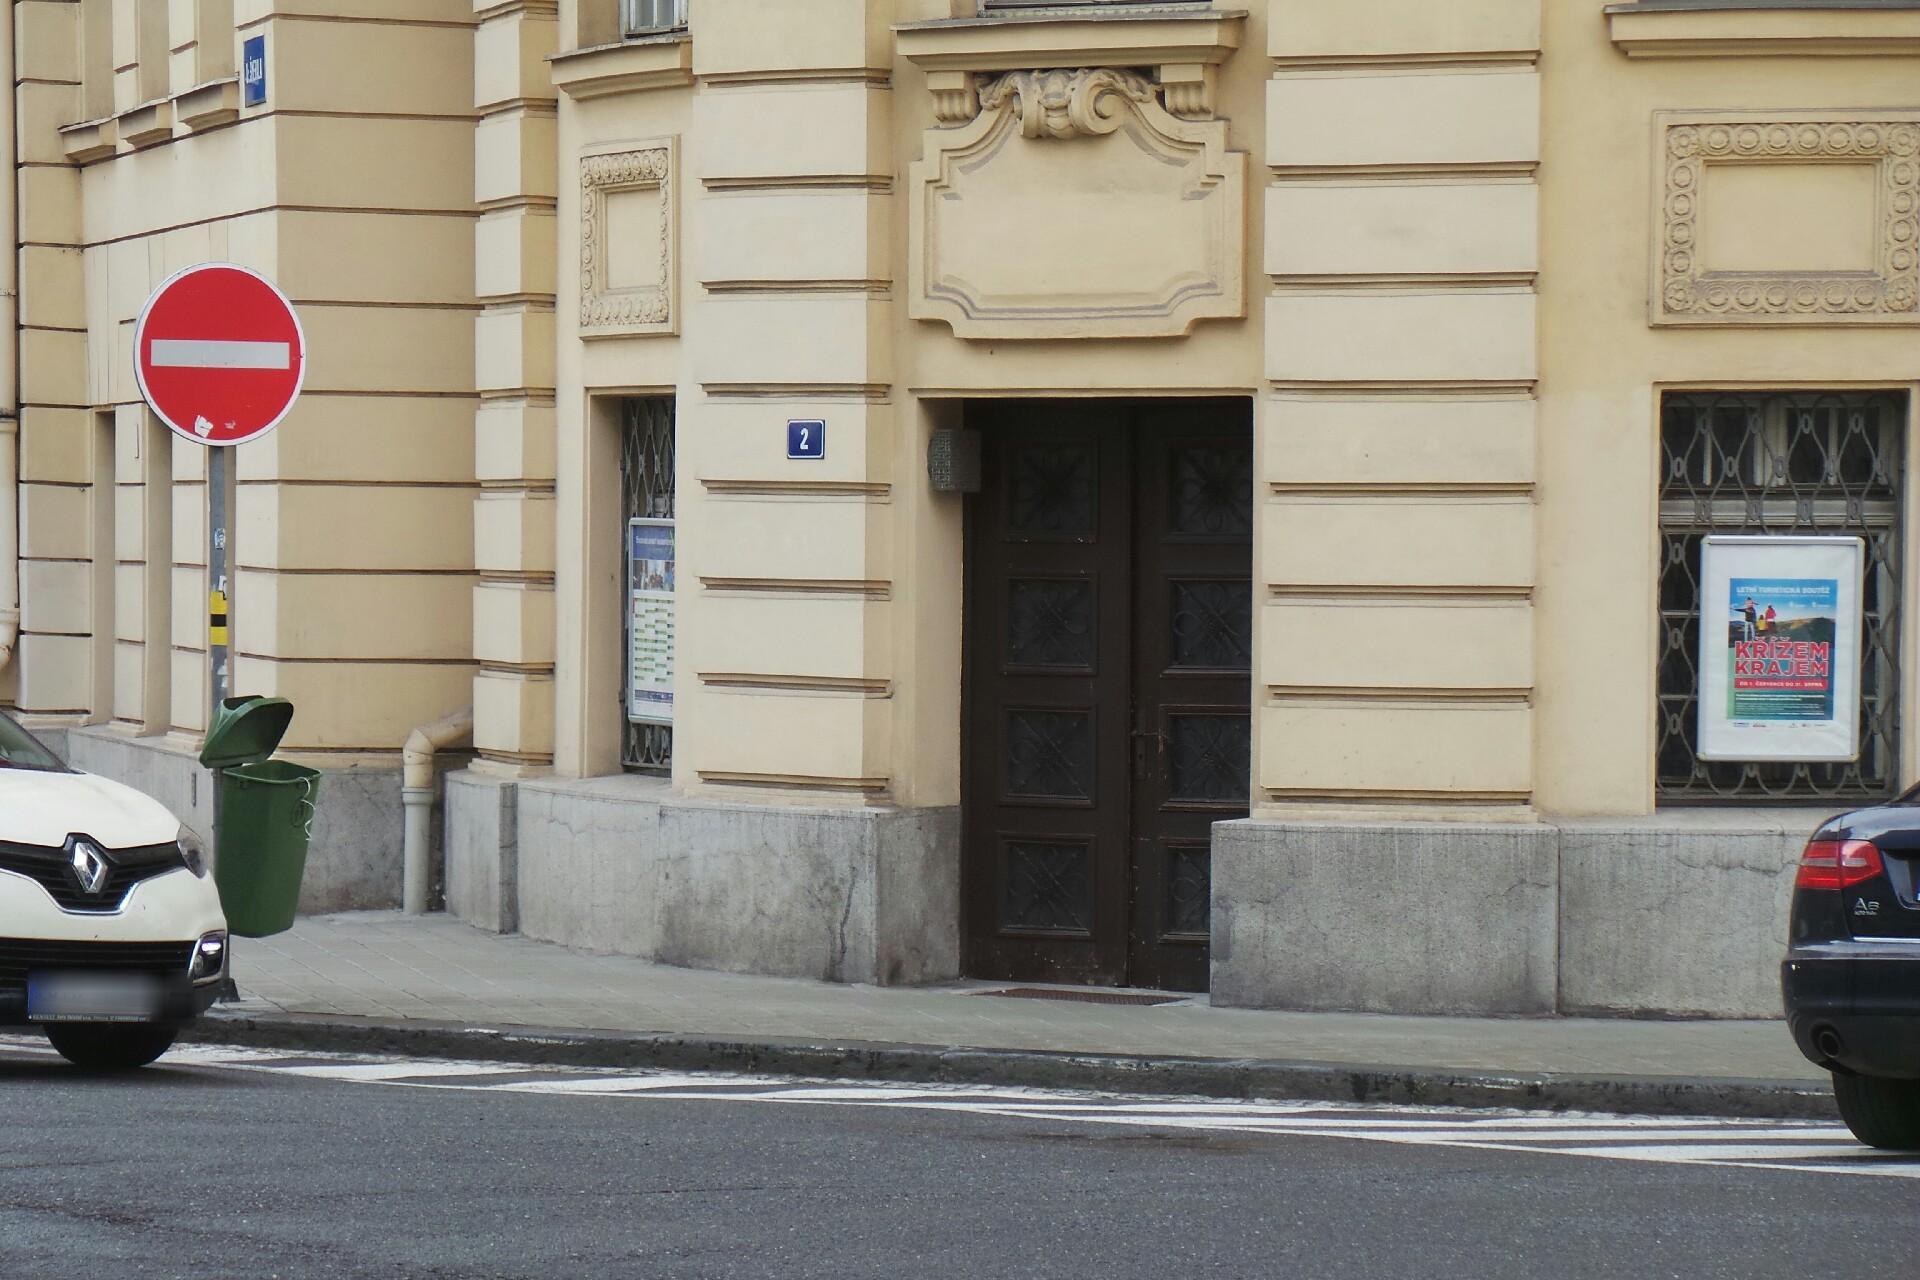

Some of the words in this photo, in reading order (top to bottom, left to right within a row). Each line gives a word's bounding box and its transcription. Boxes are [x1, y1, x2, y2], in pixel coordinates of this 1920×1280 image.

[800, 428, 809, 450] 2
[1735, 636, 1830, 661] KŘÍŽEM
[1735, 660, 1830, 677] KRAJEM
[1855, 897, 1880, 911] A6
